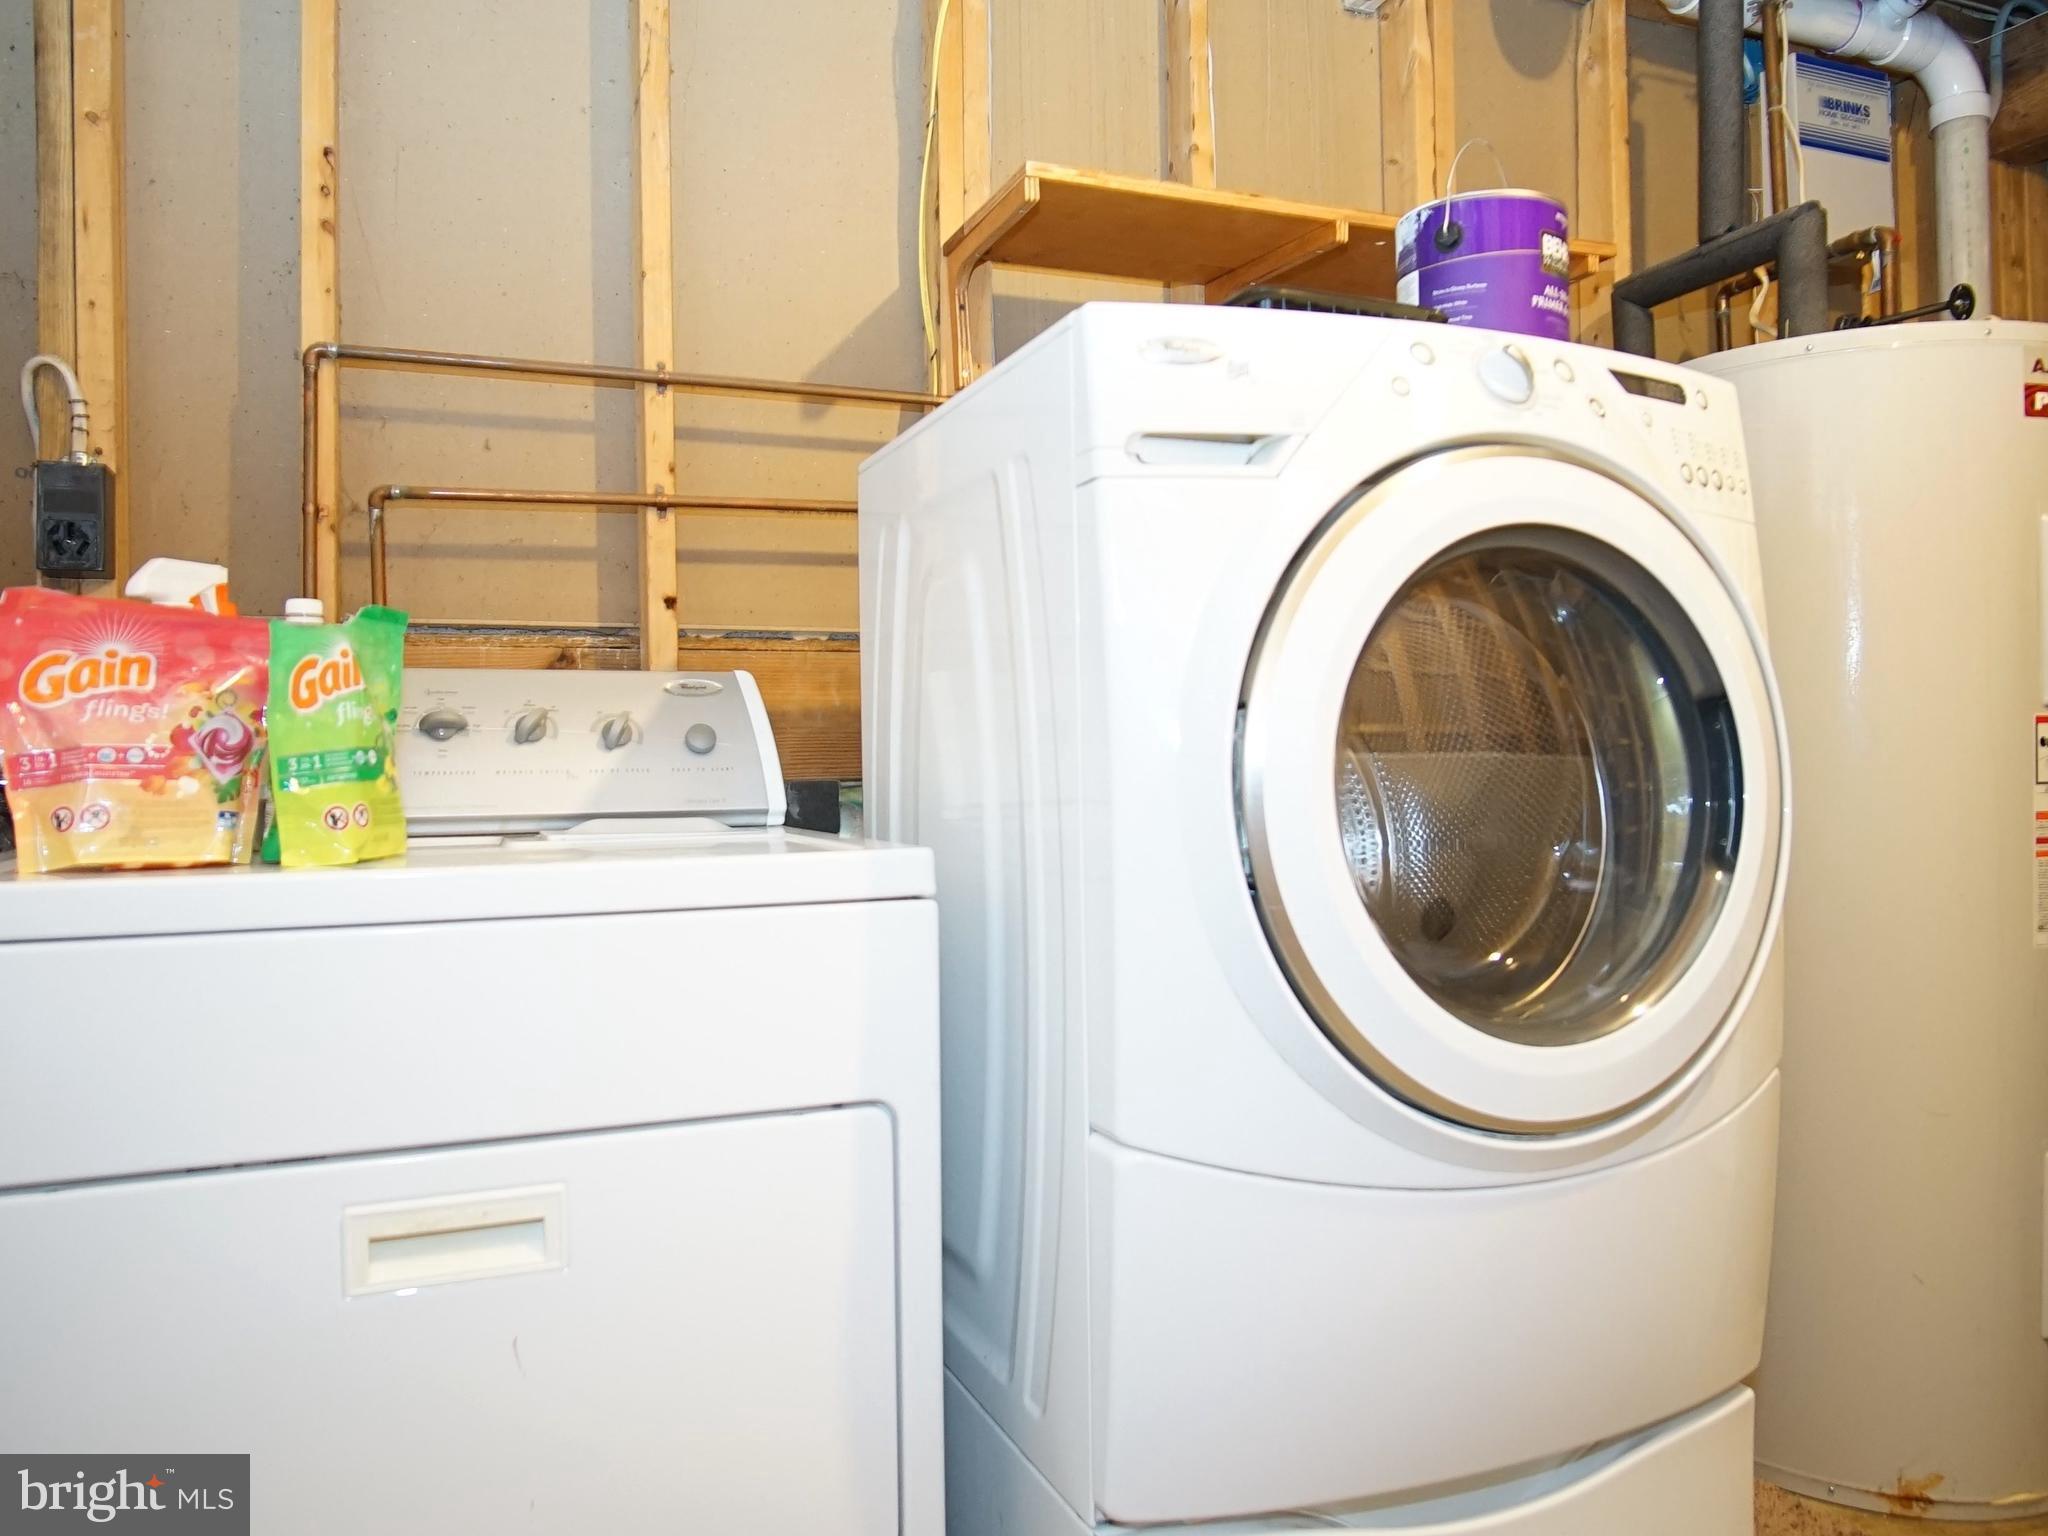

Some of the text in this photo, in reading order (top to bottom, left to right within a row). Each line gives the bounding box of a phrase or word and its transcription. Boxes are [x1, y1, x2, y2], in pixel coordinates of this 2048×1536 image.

[1826, 96, 1871, 118] BRINKS
[22, 649, 151, 704] Gain
[80, 699, 169, 722] flings!
[19, 756, 31, 771] 3
